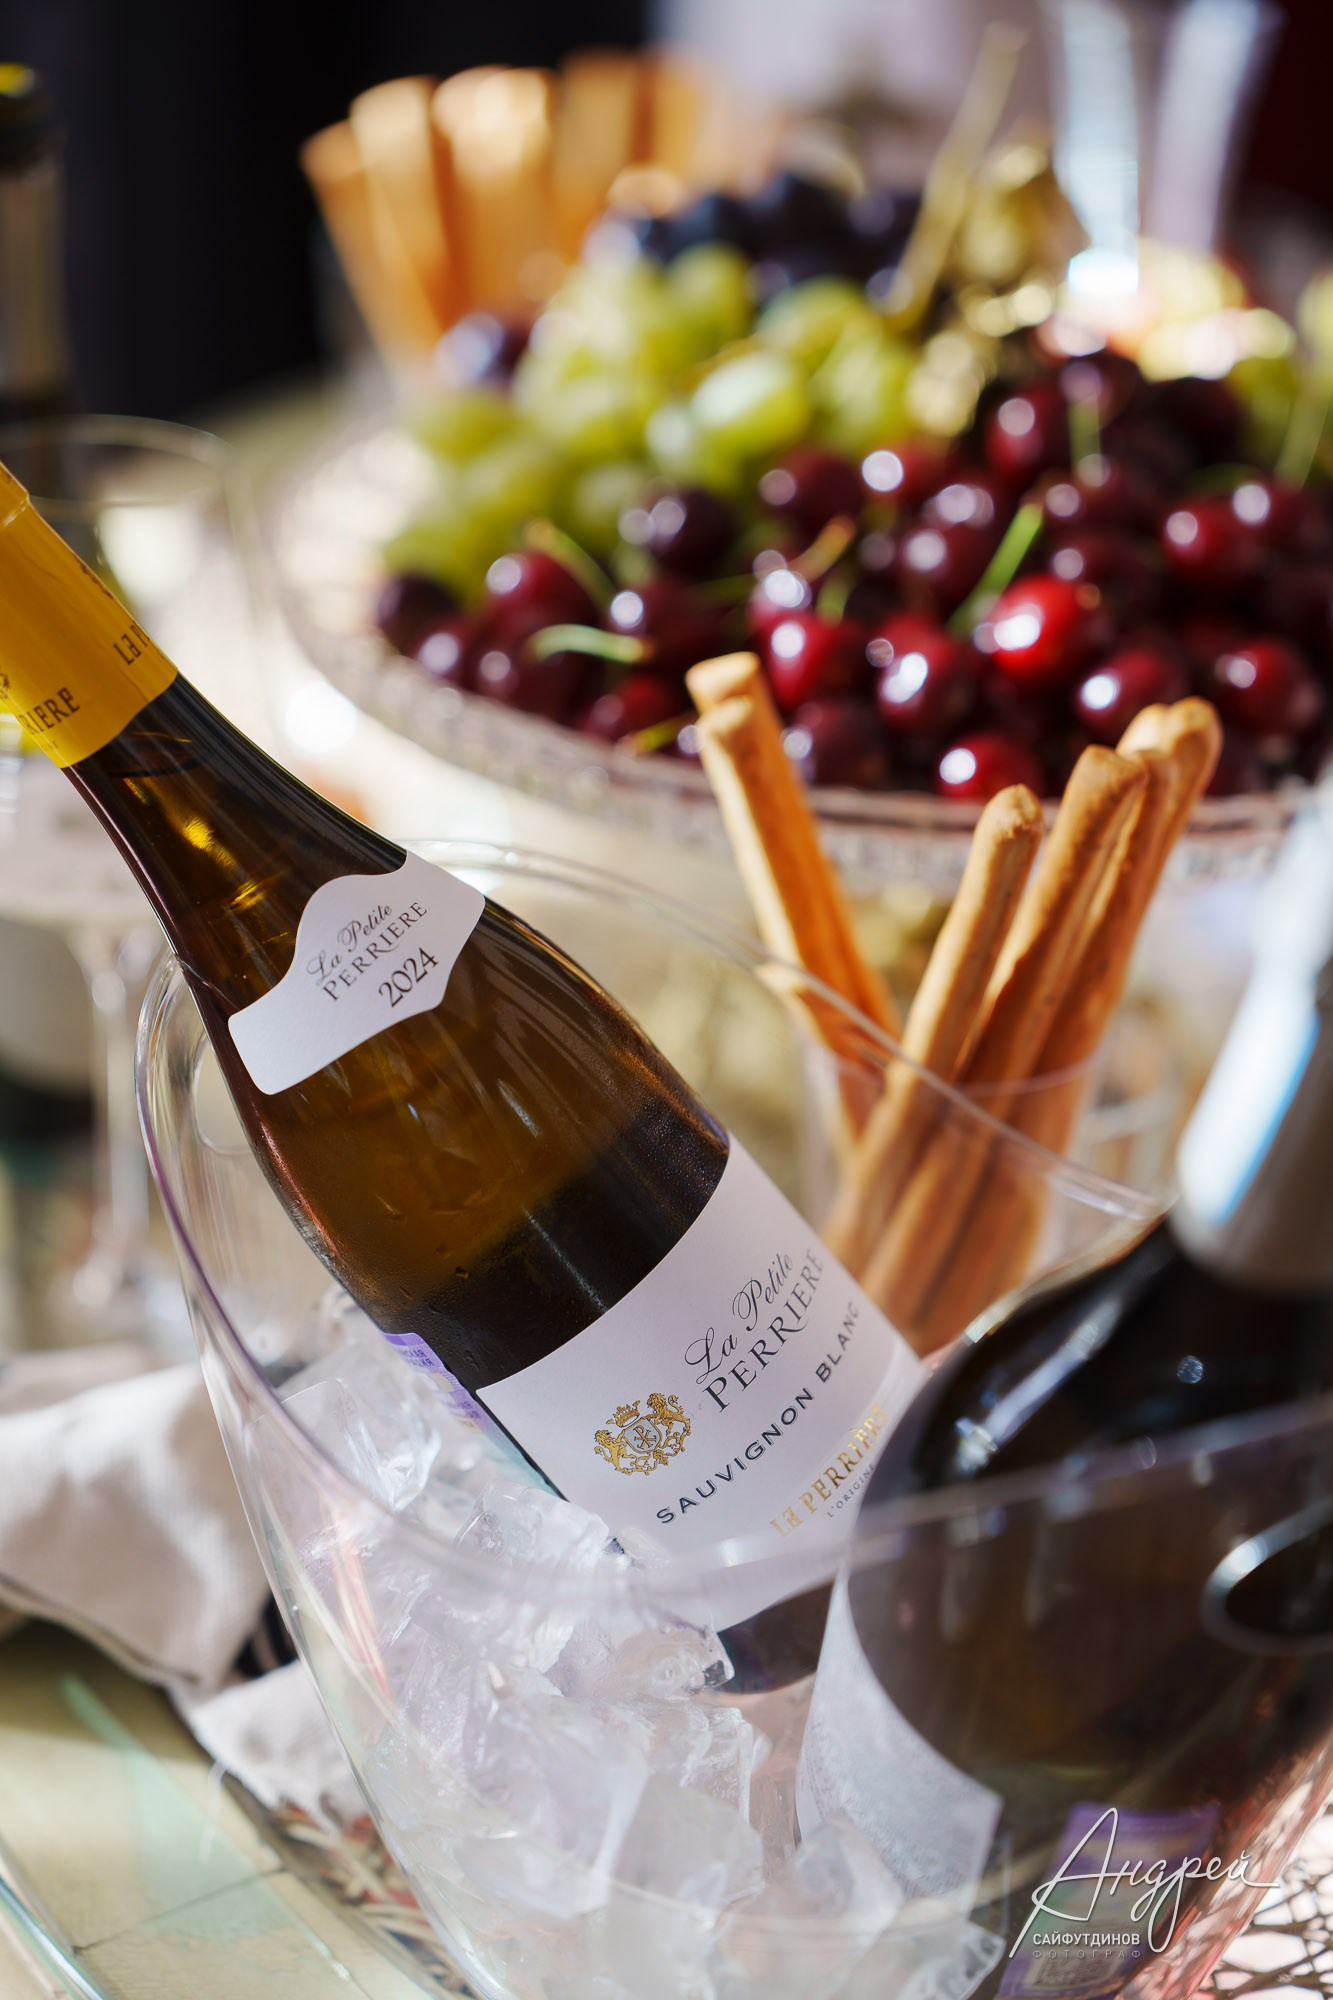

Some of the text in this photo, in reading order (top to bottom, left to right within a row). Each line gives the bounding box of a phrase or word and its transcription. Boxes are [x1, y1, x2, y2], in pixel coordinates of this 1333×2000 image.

[306, 903, 393, 986] La Petite
[322, 902, 428, 1002] PERRIERE
[378, 947, 440, 1008] 2024
[685, 1253, 793, 1385] La Petite
[702, 1249, 824, 1413] PERRIERE
[656, 1301, 860, 1524] SAUVIGNON BLANC
